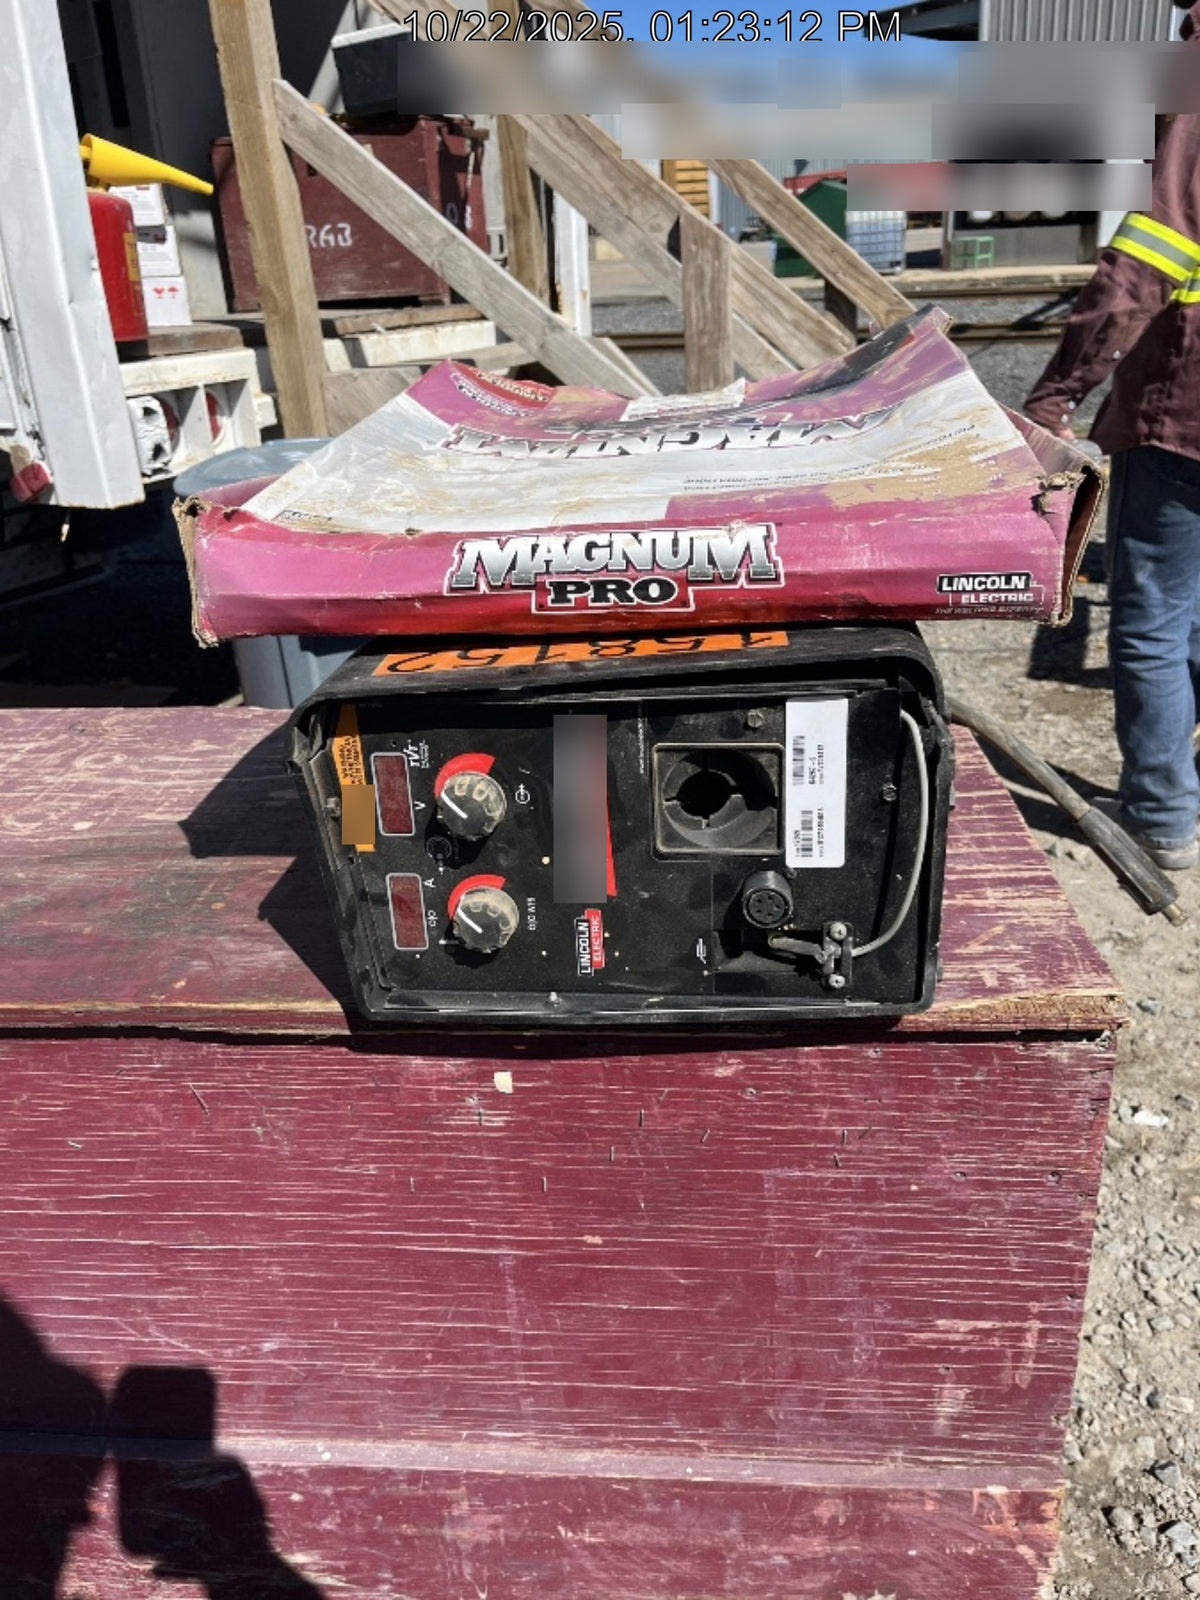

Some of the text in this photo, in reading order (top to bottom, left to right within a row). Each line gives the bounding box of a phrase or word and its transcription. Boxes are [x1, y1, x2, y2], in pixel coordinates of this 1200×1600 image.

[450, 524, 778, 589] MAGNUM
[547, 576, 677, 606] PRO
[941, 574, 1026, 592] LINCOLN
[960, 592, 1034, 605] ELECTRIC
[577, 920, 592, 974] LINCOLN
[590, 913, 602, 962] ELECTRIC
